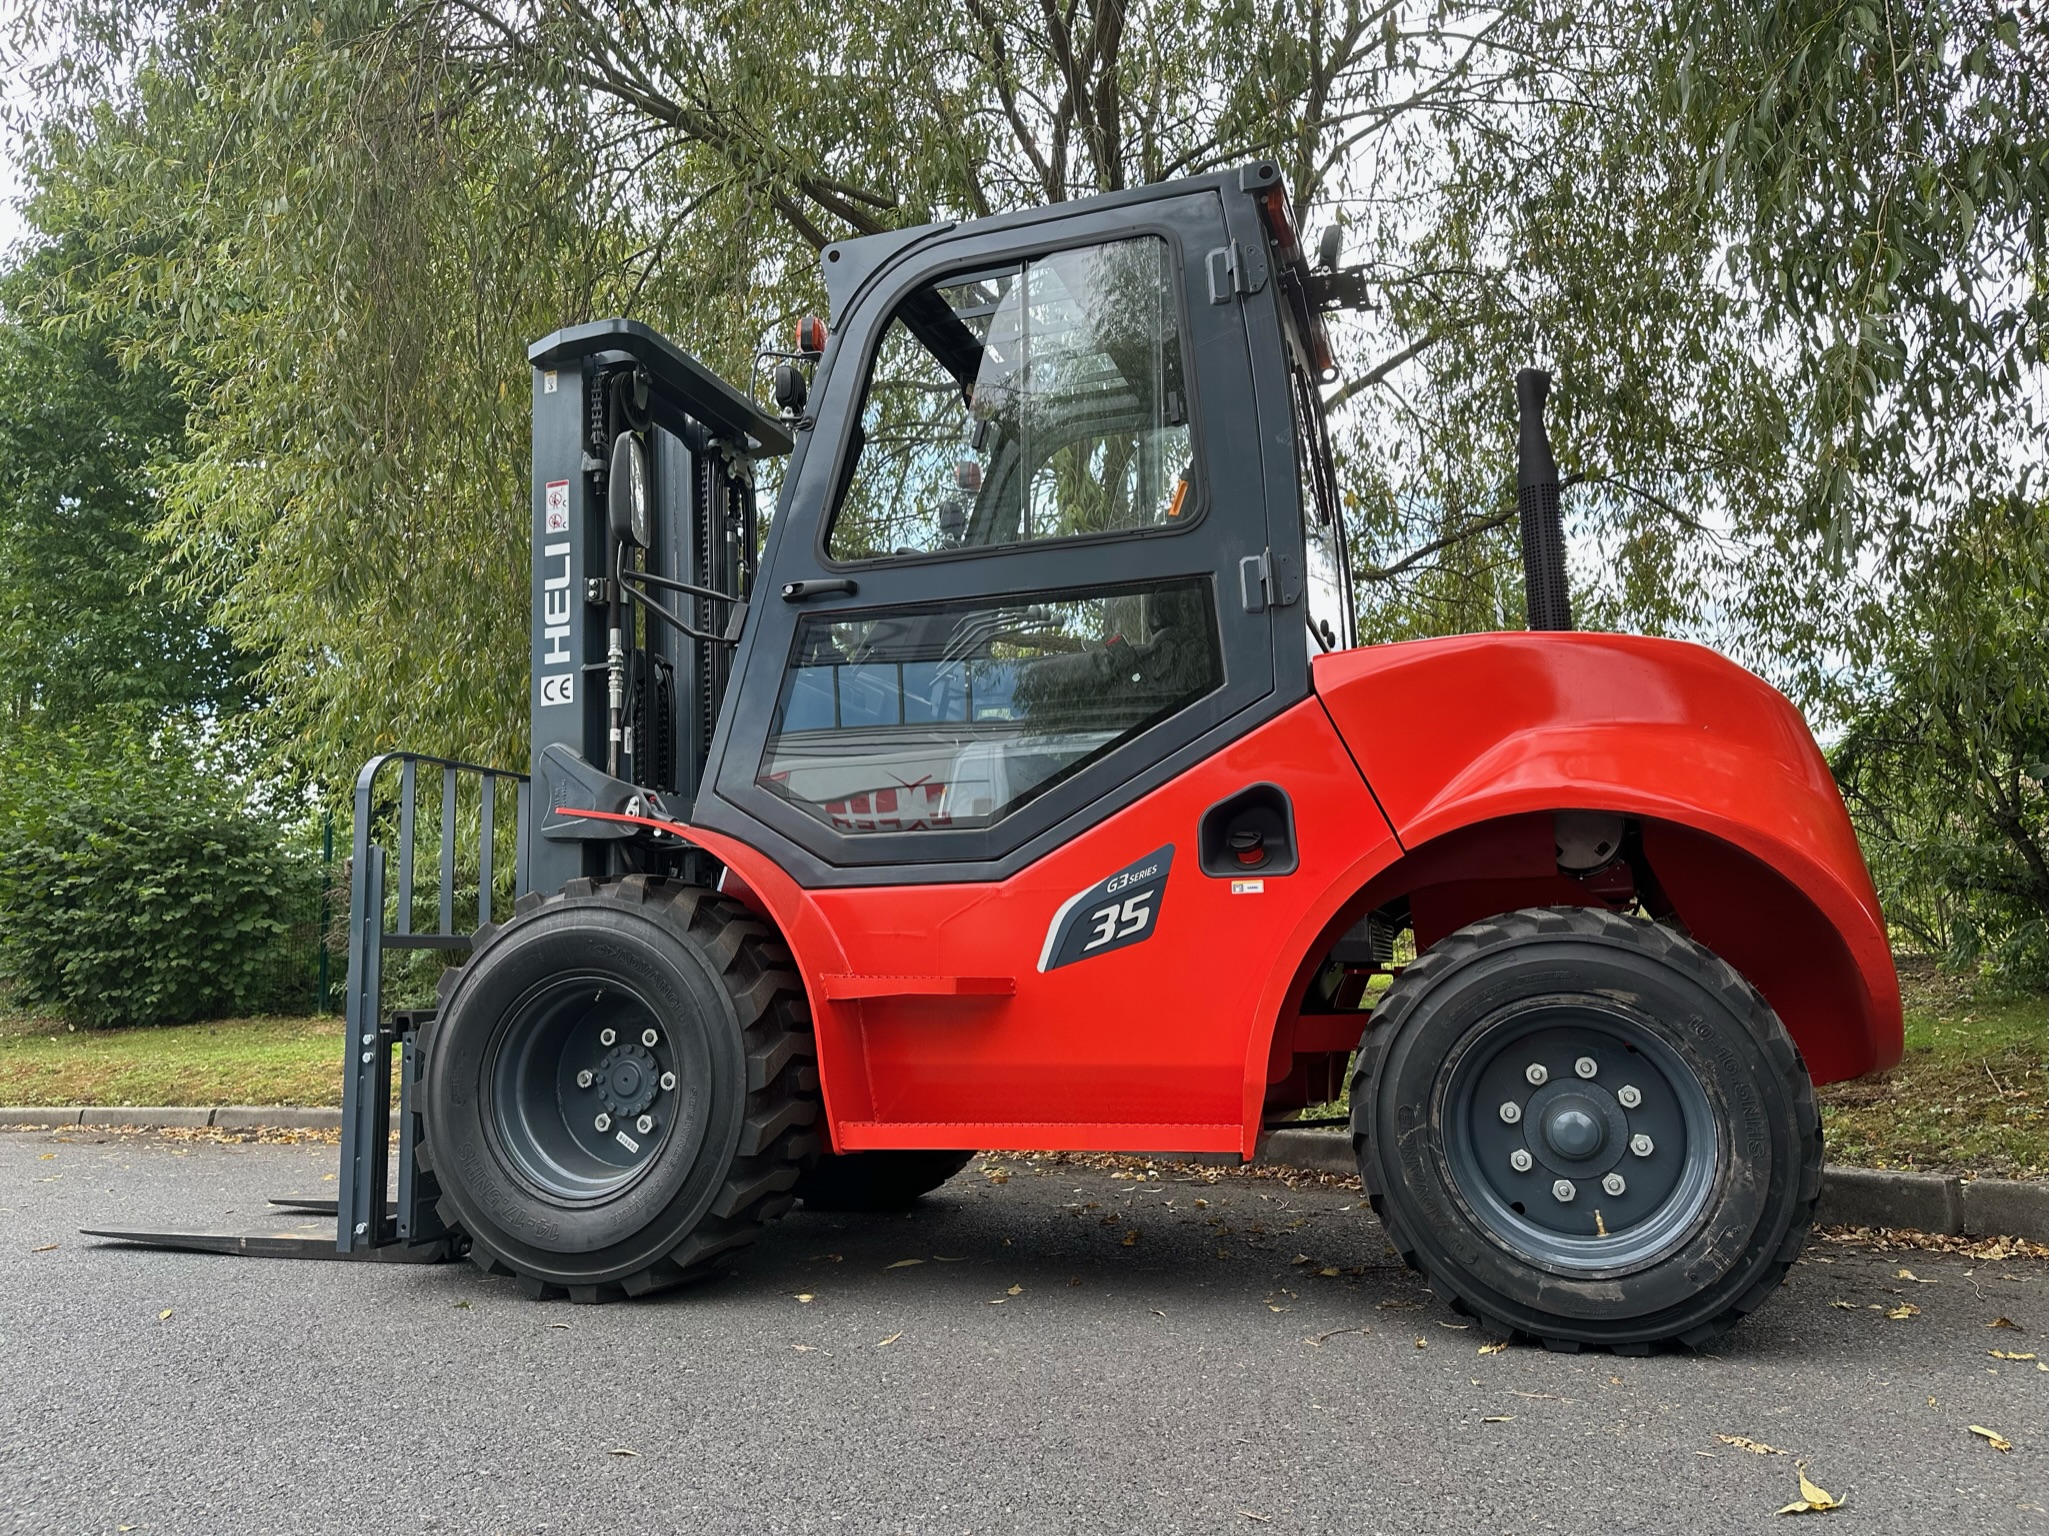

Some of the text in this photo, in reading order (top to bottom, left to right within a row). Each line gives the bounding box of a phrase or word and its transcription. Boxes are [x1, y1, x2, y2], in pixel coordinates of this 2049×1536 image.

[544, 542, 571, 665] HELI
[543, 677, 571, 701] CE
[1107, 864, 1158, 893] G3 SERIES
[1083, 889, 1155, 952] 35
[457, 1141, 560, 1241] 14-17.5NHS
